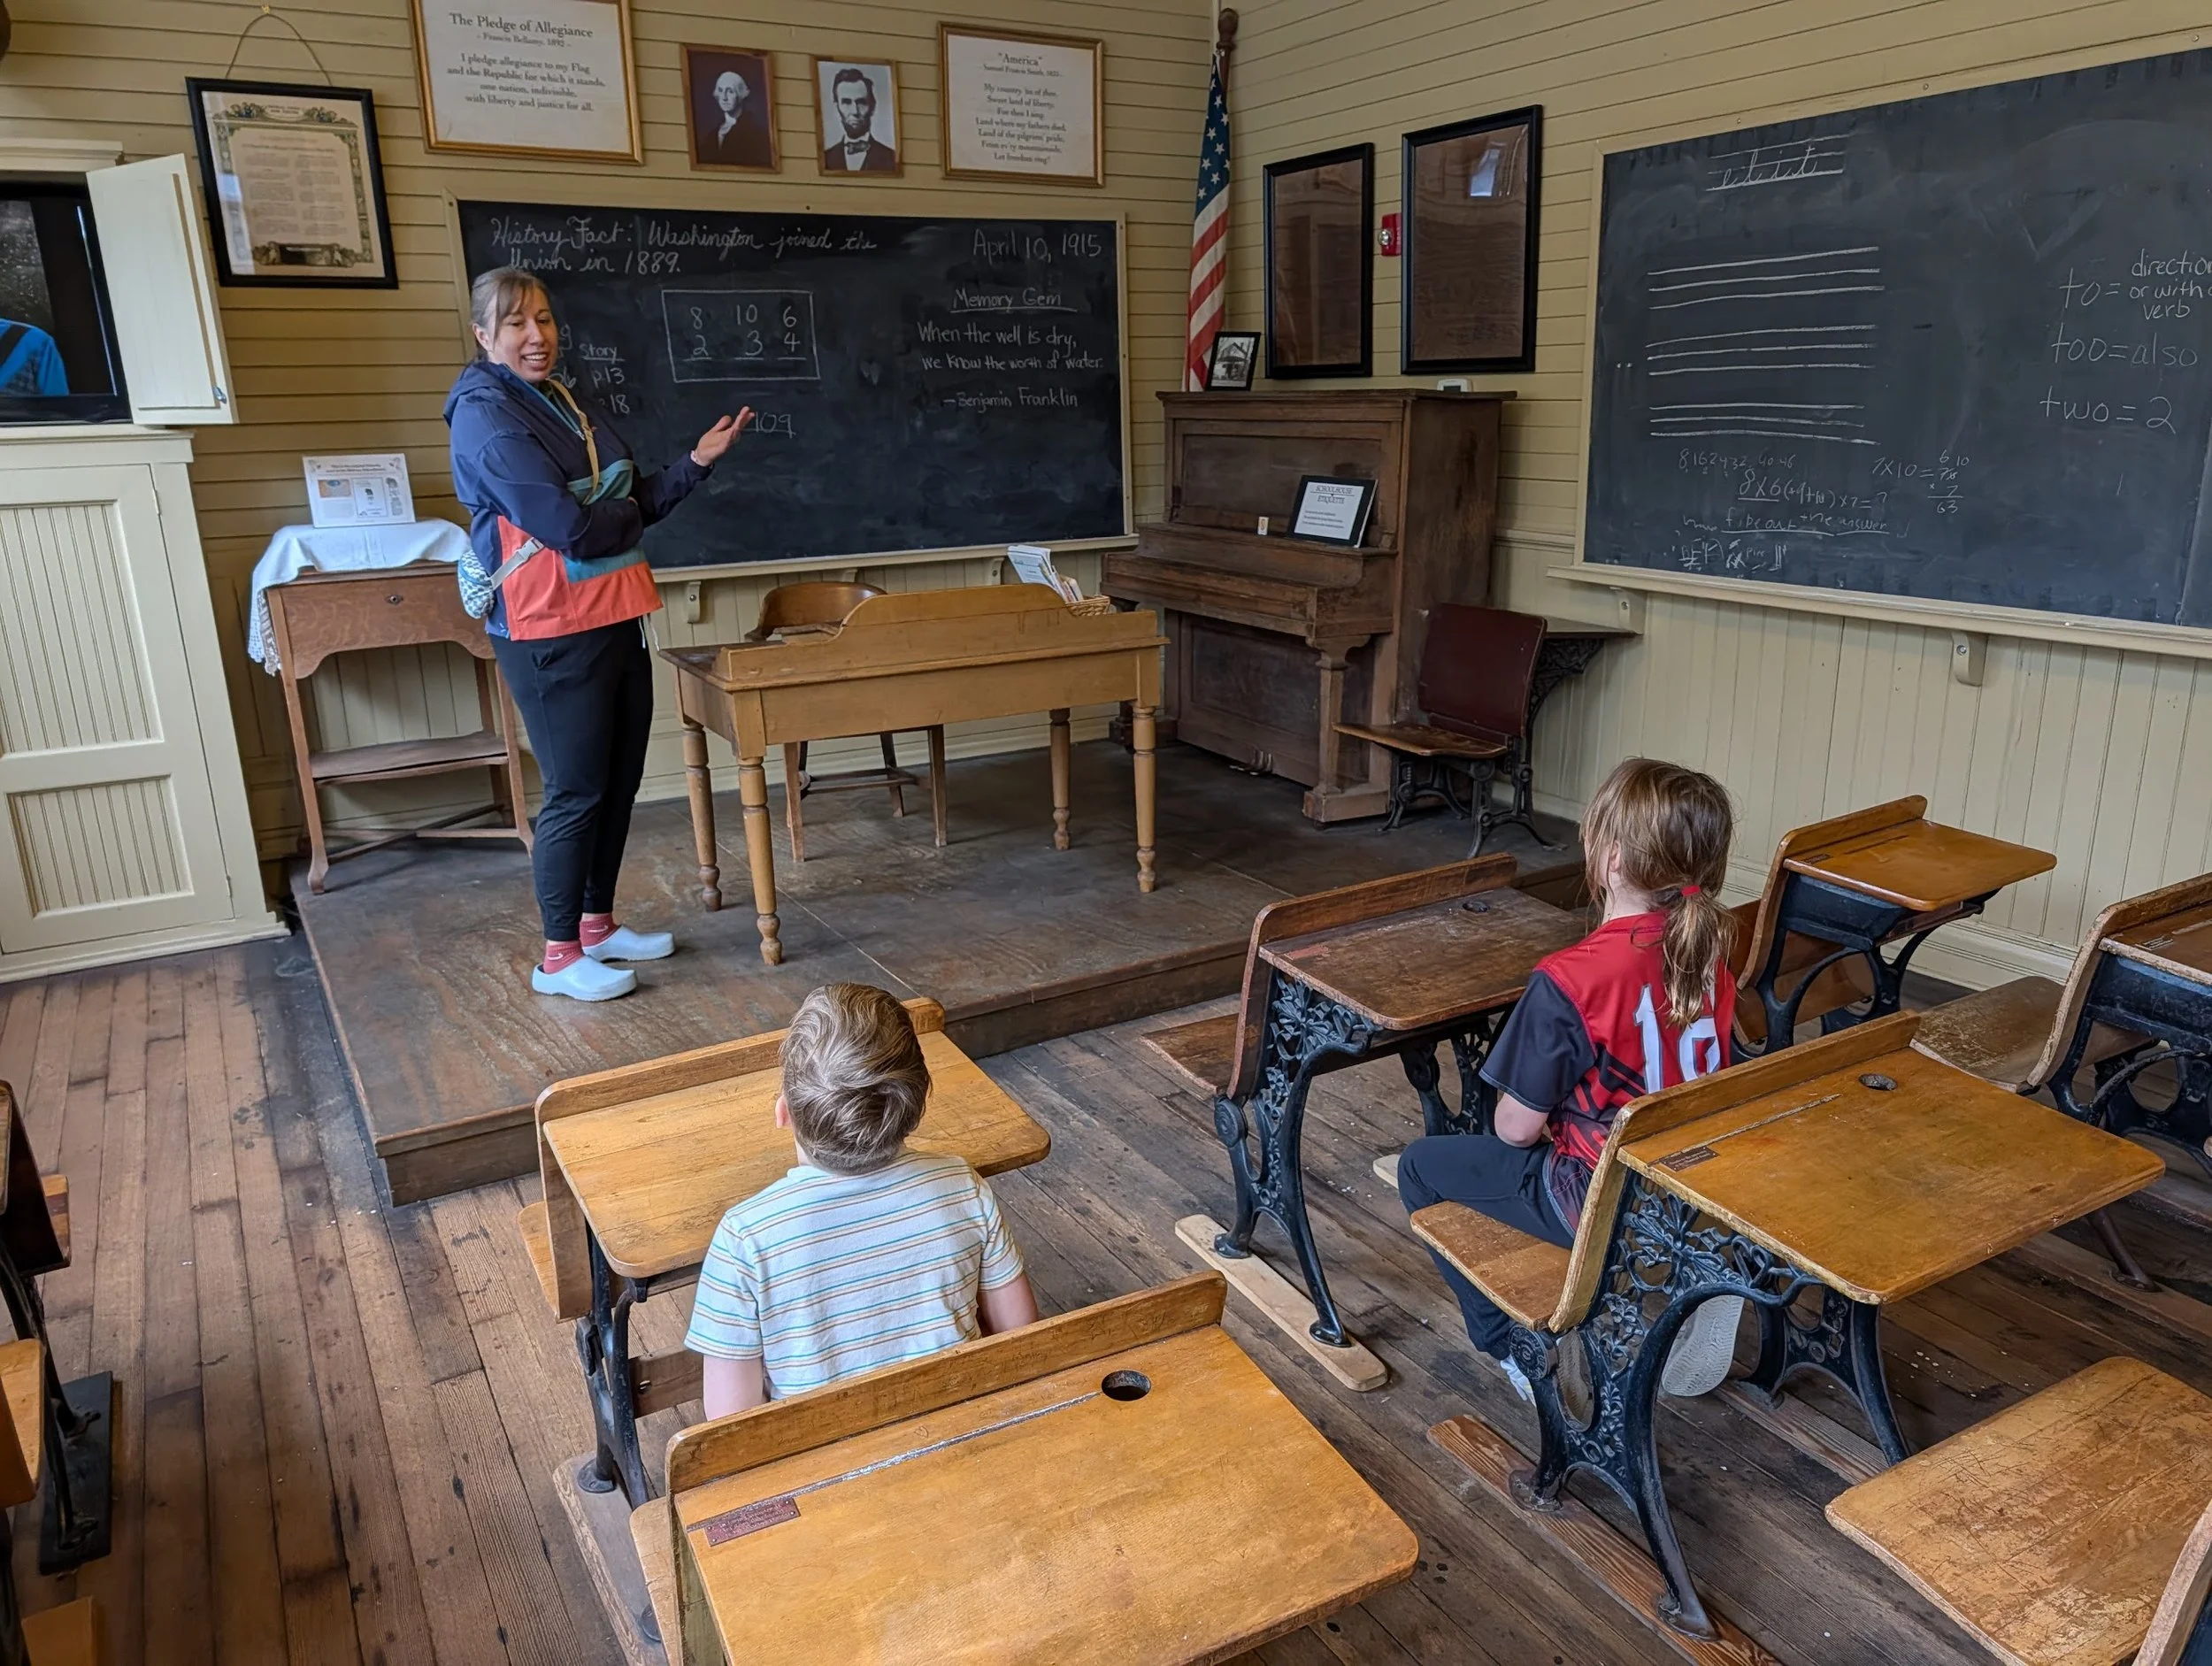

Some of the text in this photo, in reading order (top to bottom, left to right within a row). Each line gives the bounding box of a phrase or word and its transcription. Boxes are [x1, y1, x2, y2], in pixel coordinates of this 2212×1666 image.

[449, 12, 594, 38] The Pledge of Allegiance
[447, 66, 464, 75] and
[465, 67, 480, 77] the
[483, 68, 523, 81] Republic
[525, 71, 537, 81] for
[540, 73, 566, 83] which
[461, 53, 466, 62] I
[468, 54, 497, 69] pledge
[499, 56, 542, 69] allegiance
[555, 63, 570, 72] my
[572, 63, 590, 75] Flag
[465, 95, 486, 104] with
[488, 95, 516, 108] liberty
[518, 98, 535, 108] and
[537, 100, 565, 111] justice
[566, 100, 580, 111] for
[975, 117, 993, 127] Land
[978, 128, 996, 138] Land
[994, 152, 1006, 161] Let
[490, 216, 878, 261] History Fact: Washington joined the
[972, 228, 1102, 265] April 10, 1915
[508, 247, 681, 275] Union in 1889.
[953, 287, 1063, 312] Memory Gem
[2130, 286, 2149, 299] or
[2154, 280, 2203, 299] with
[689, 304, 797, 330] 8 10 6
[2143, 299, 2191, 320] verb
[693, 330, 801, 356] 2 3 4
[917, 320, 1078, 358] When the well is dry,
[579, 342, 618, 365] Story
[985, 355, 1006, 372] the
[1009, 356, 1042, 369] worth
[1047, 349, 1061, 369] of
[1018, 387, 1079, 407] Franklin
[1839, 518, 1887, 531] answer
